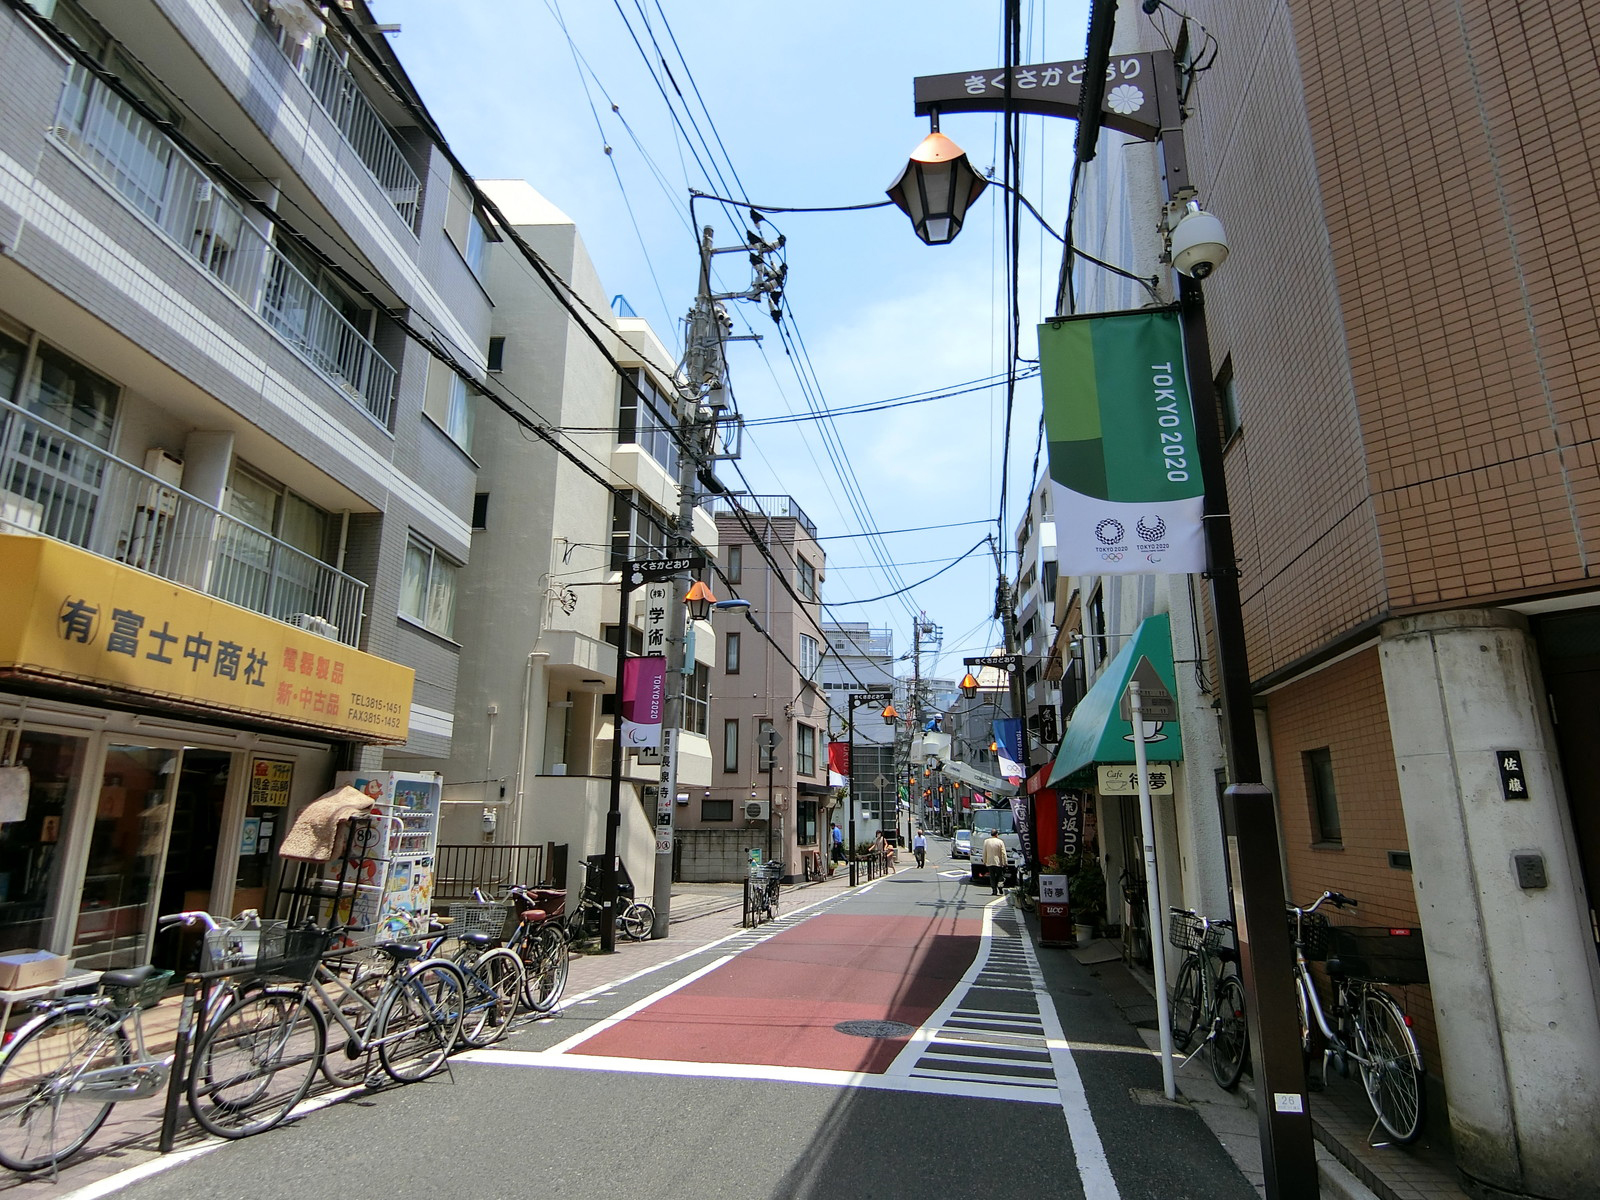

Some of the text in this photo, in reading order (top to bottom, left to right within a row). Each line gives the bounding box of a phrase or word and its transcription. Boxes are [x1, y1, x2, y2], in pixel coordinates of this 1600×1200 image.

[1151, 362, 1189, 482] TOKYO 2020
[632, 559, 690, 571] きくさかどおり
[283, 646, 344, 684] 電器製品
[974, 656, 1015, 664] きくさかどおり
[651, 675, 661, 719] TOKYO 2020
[660, 755, 670, 798] 長泉寺
[1106, 770, 1123, 780] Cafe
[1047, 906, 1063, 914] UCC
[1281, 1095, 1295, 1105] 26
